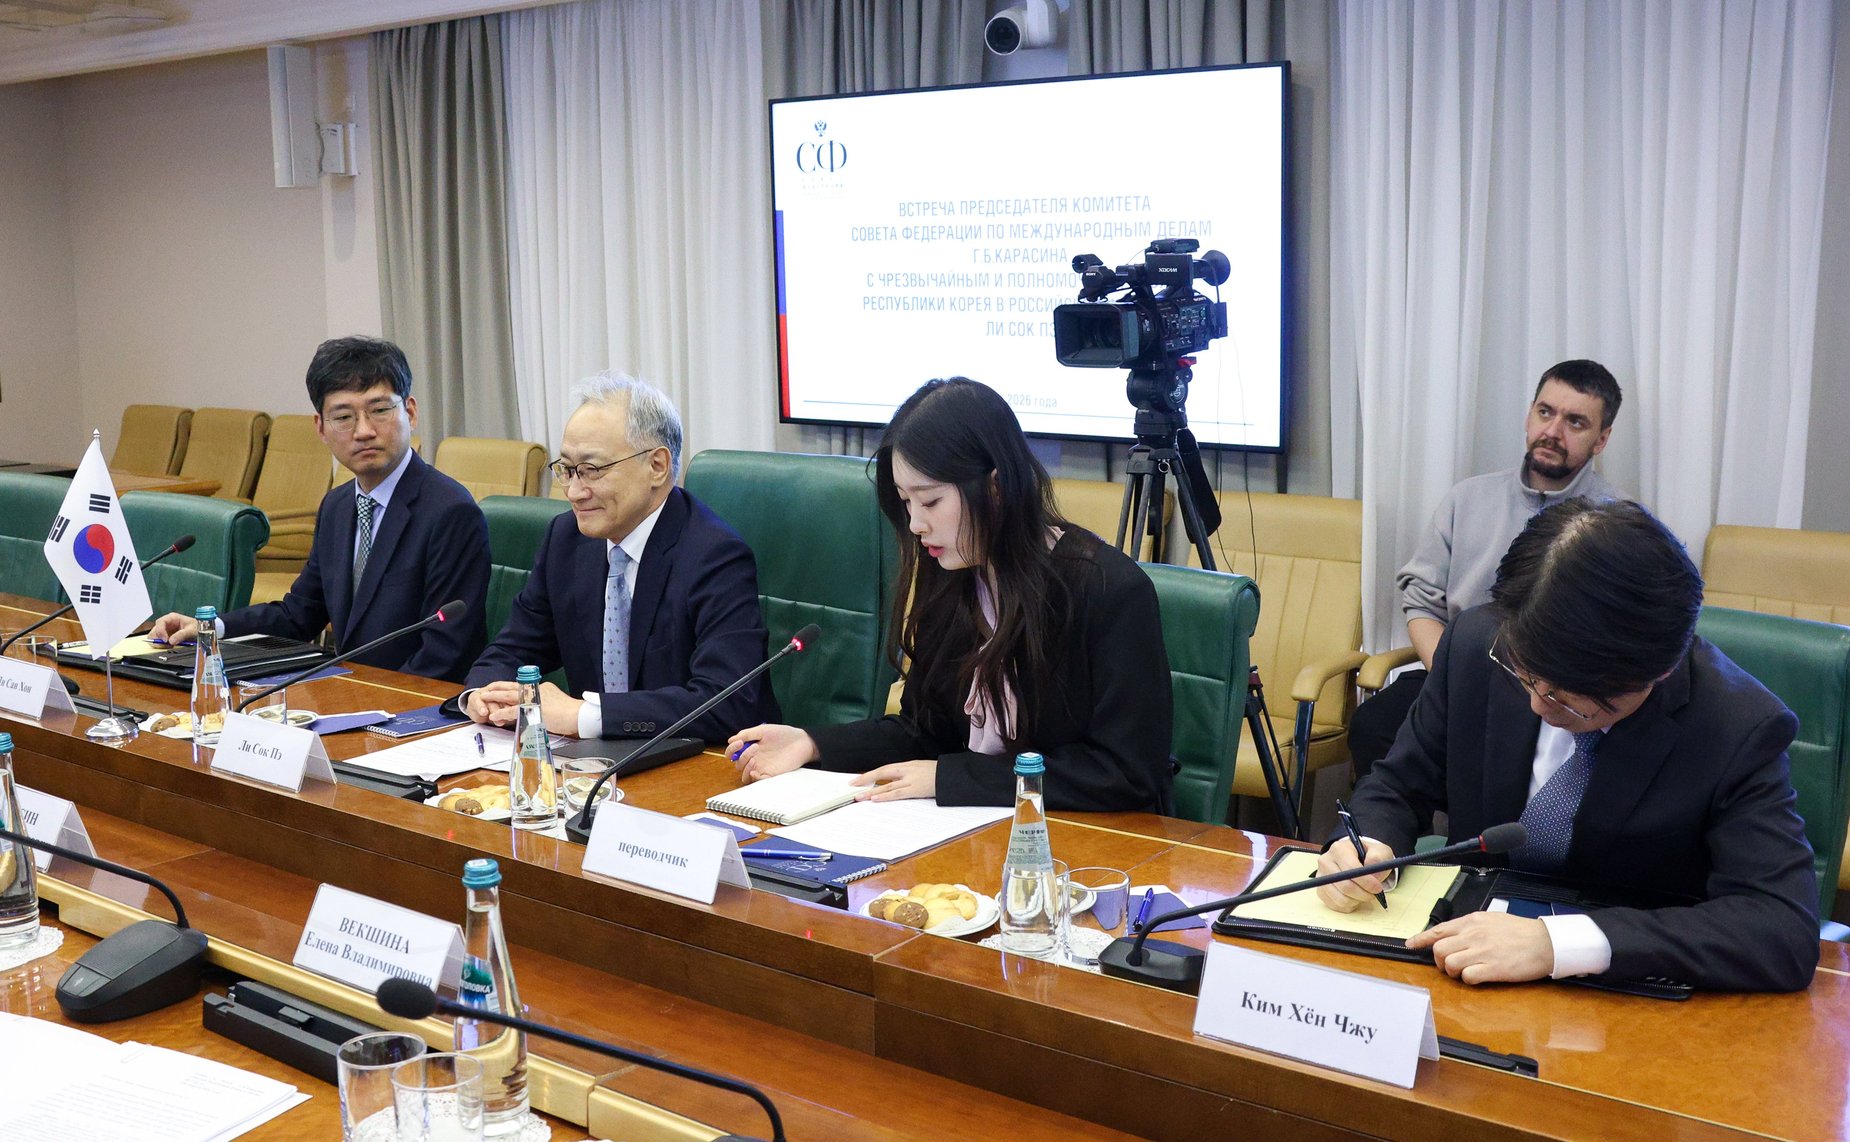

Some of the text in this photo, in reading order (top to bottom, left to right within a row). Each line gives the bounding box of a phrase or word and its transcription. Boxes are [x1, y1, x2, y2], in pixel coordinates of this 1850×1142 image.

[796, 140, 847, 174] СФ
[899, 195, 1151, 217] ВСТРЕЧА ПРЕДСЕДАТЕЛЯ КОМИТЕТА
[851, 220, 1212, 243] СОВЕТА ФЕДЕРАЦИИ ПО МЕЖДУНАРОДНЫМ ДЕЛАМ
[973, 247, 1068, 264] Г.Б.КАРАСИНА
[867, 269, 1082, 288] С ЧРЕЗВЫЧАЙНЫМ И ПОЛНОМО
[863, 296, 945, 311] РЕСПУБЛИКИ
[950, 296, 991, 312] КОРЕЯ
[996, 297, 1004, 312] В
[986, 321, 1004, 336] ЛИ
[1008, 321, 1035, 337] СОК
[1007, 393, 1058, 409] 2026 года
[238, 739, 282, 760] Ли Сок Пэ
[618, 840, 689, 869] переводчик
[338, 916, 410, 955] ВЕКШИНА
[304, 930, 433, 988] Елена Владимировна
[1240, 991, 1378, 1044] Ким Хён Чжу
